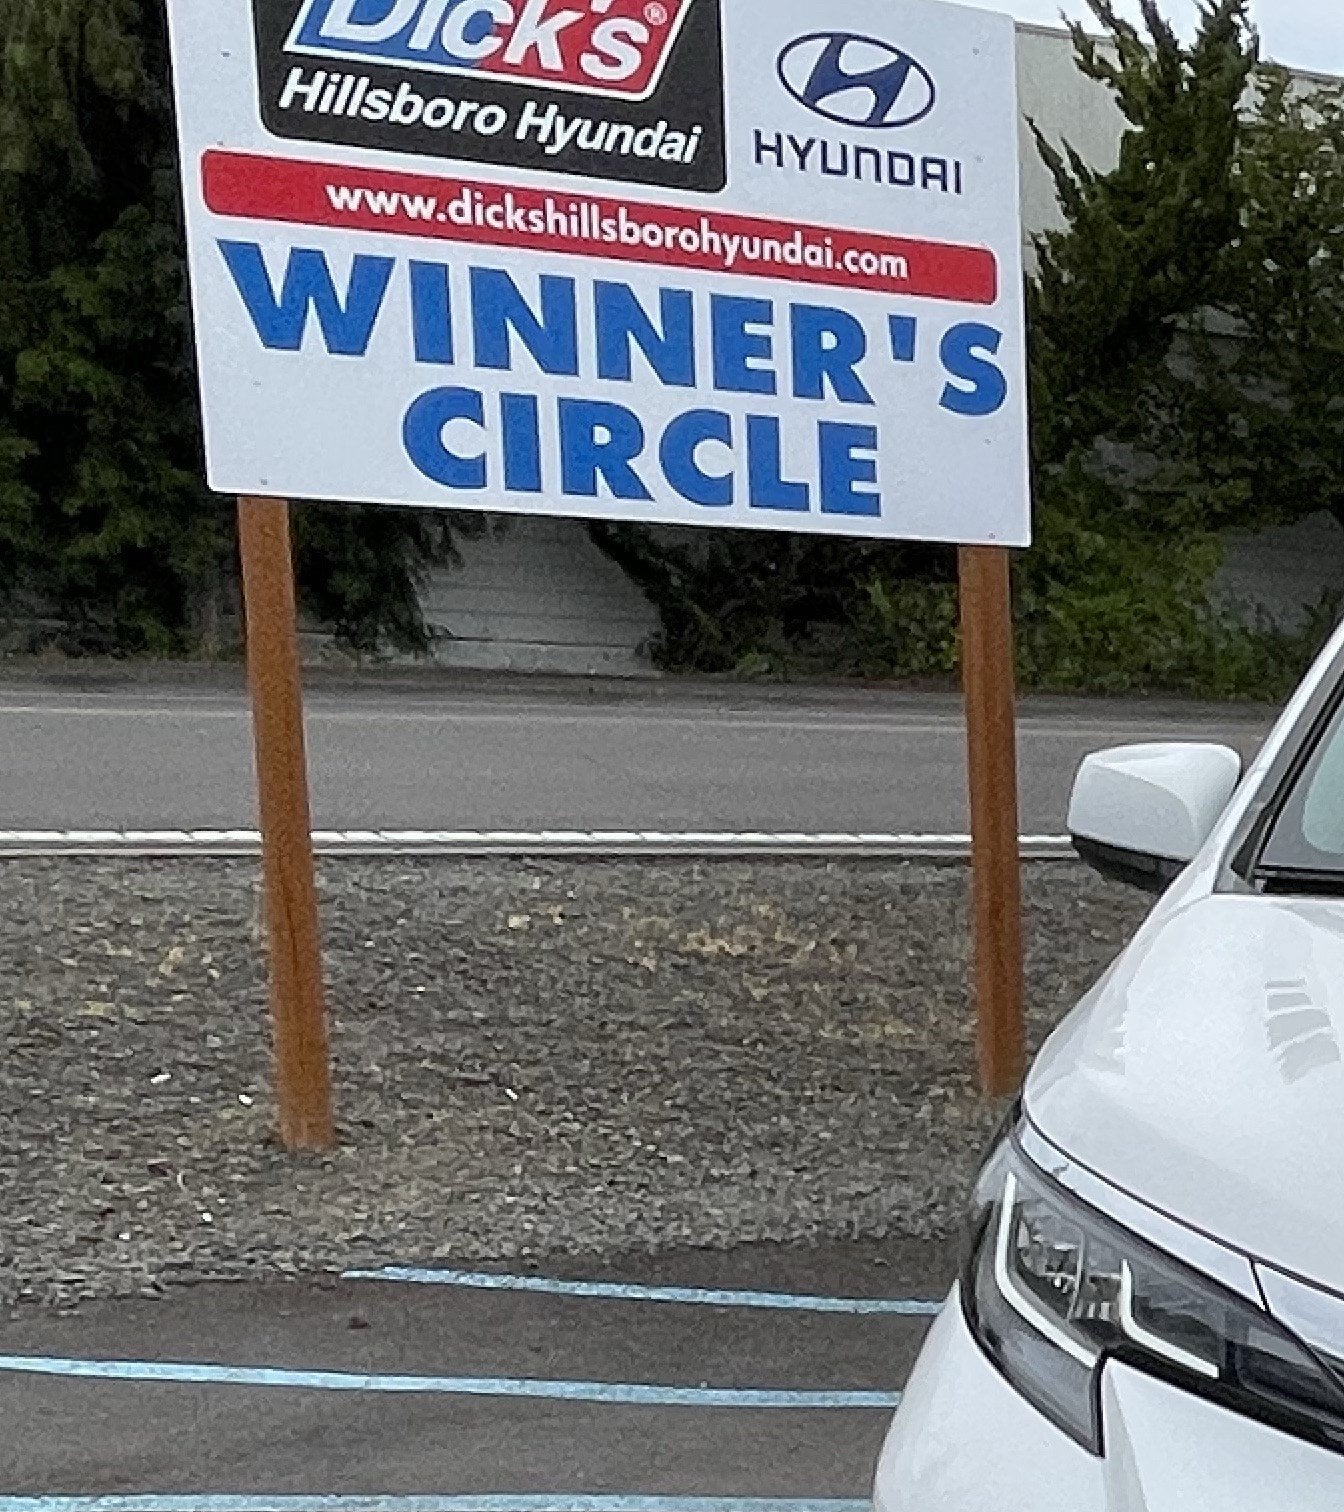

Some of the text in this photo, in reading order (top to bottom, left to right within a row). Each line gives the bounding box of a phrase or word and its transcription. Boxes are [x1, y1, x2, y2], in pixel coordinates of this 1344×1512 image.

[279, 67, 703, 164] Hillsboro Hyundai
[755, 129, 963, 195] HYUNDAI
[325, 179, 909, 280] www.dickshillsborohyundai.com
[216, 238, 1009, 416] WINNER'S
[402, 385, 883, 518] CIRCLE
